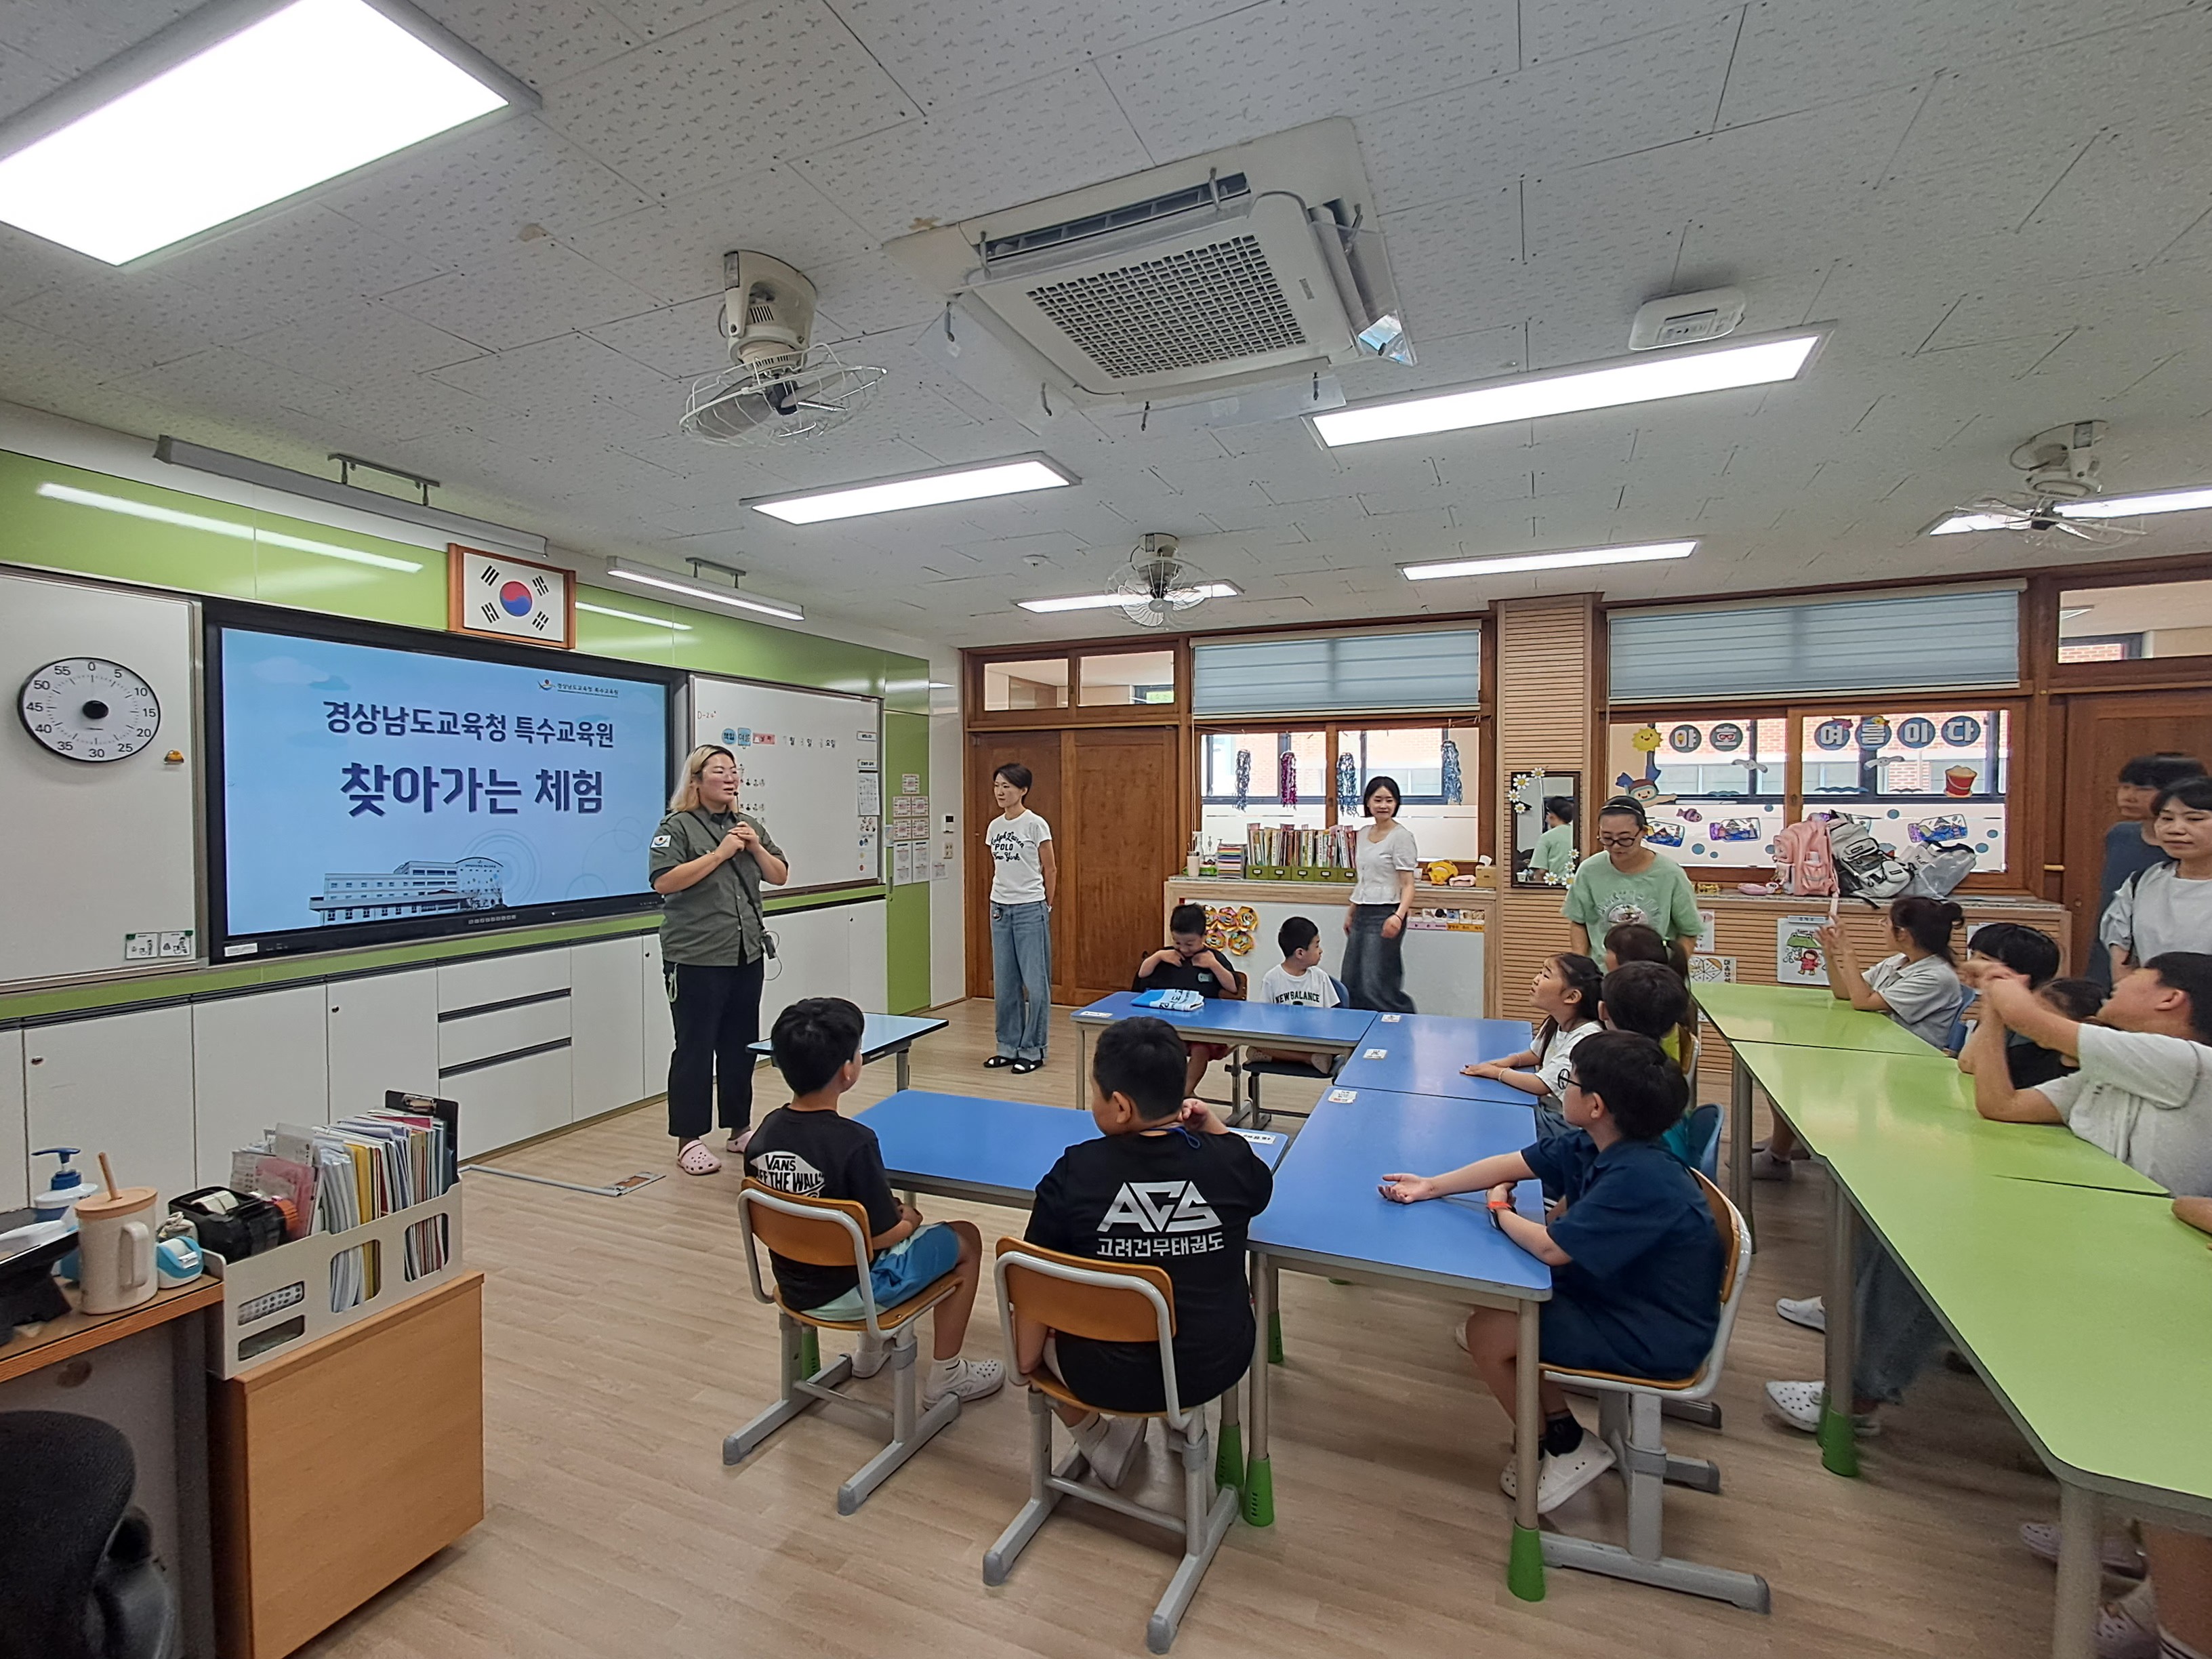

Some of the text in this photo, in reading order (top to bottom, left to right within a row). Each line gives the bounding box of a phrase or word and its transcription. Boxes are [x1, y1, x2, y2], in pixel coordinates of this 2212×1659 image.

[54, 665, 70, 676] 55
[88, 662, 96, 671] 0
[114, 670, 122, 678] 5
[34, 680, 50, 690] 50
[134, 688, 148, 697] 10
[26, 702, 43, 712] 45
[143, 709, 157, 717] 15
[35, 724, 52, 733] 40
[323, 701, 614, 748] 경상남도교육청 특수교육원
[136, 729, 151, 737] 20
[1675, 720, 1974, 747] 야호 여름이다
[57, 741, 73, 751] 35
[118, 743, 134, 752] 25
[89, 749, 105, 758] 30
[340, 762, 602, 817] 찾아가는 체험
[1275, 991, 1320, 1004] NEW BALANCE
[765, 1155, 796, 1172] VANS
[769, 1172, 791, 1193] THE
[1097, 1232, 1225, 1257] 고려건무태권도
